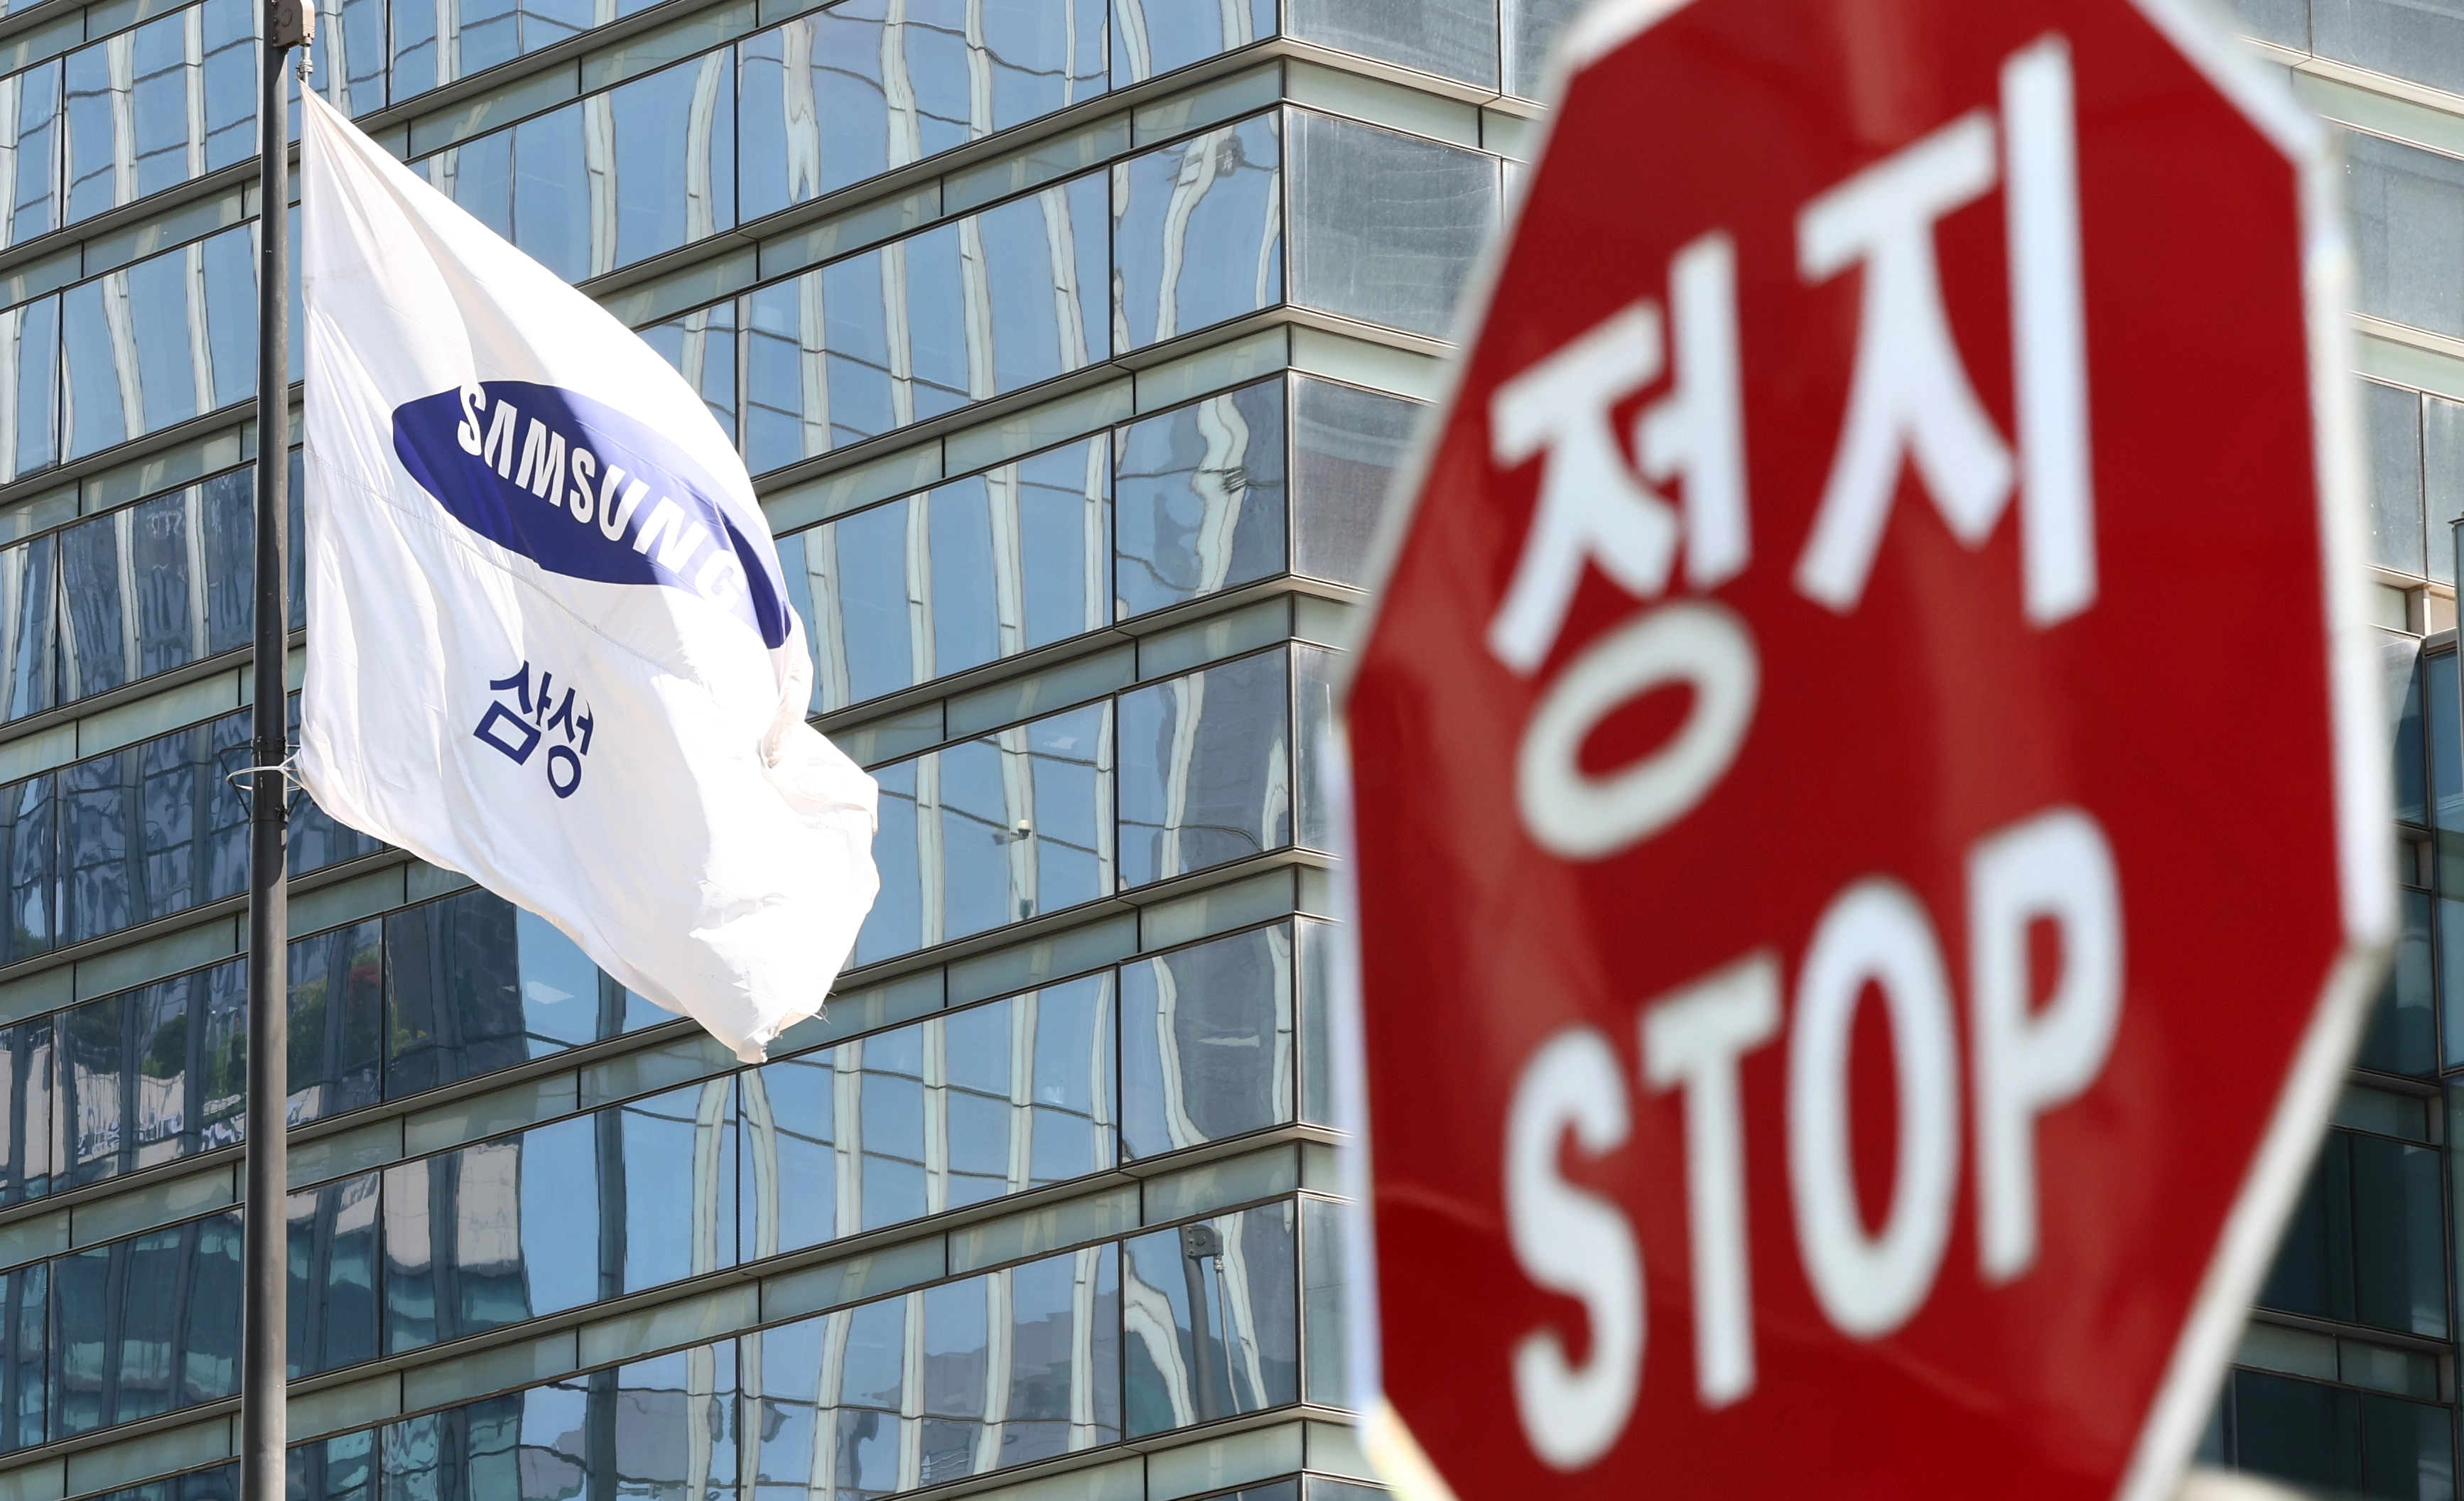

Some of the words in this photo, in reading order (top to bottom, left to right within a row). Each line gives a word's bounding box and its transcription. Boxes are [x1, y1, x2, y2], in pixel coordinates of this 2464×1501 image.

[456, 384, 747, 613] SAMSUNG
[1489, 38, 2095, 856] 정지
[472, 660, 594, 798] 삼성
[1507, 811, 2122, 1467] STOP
